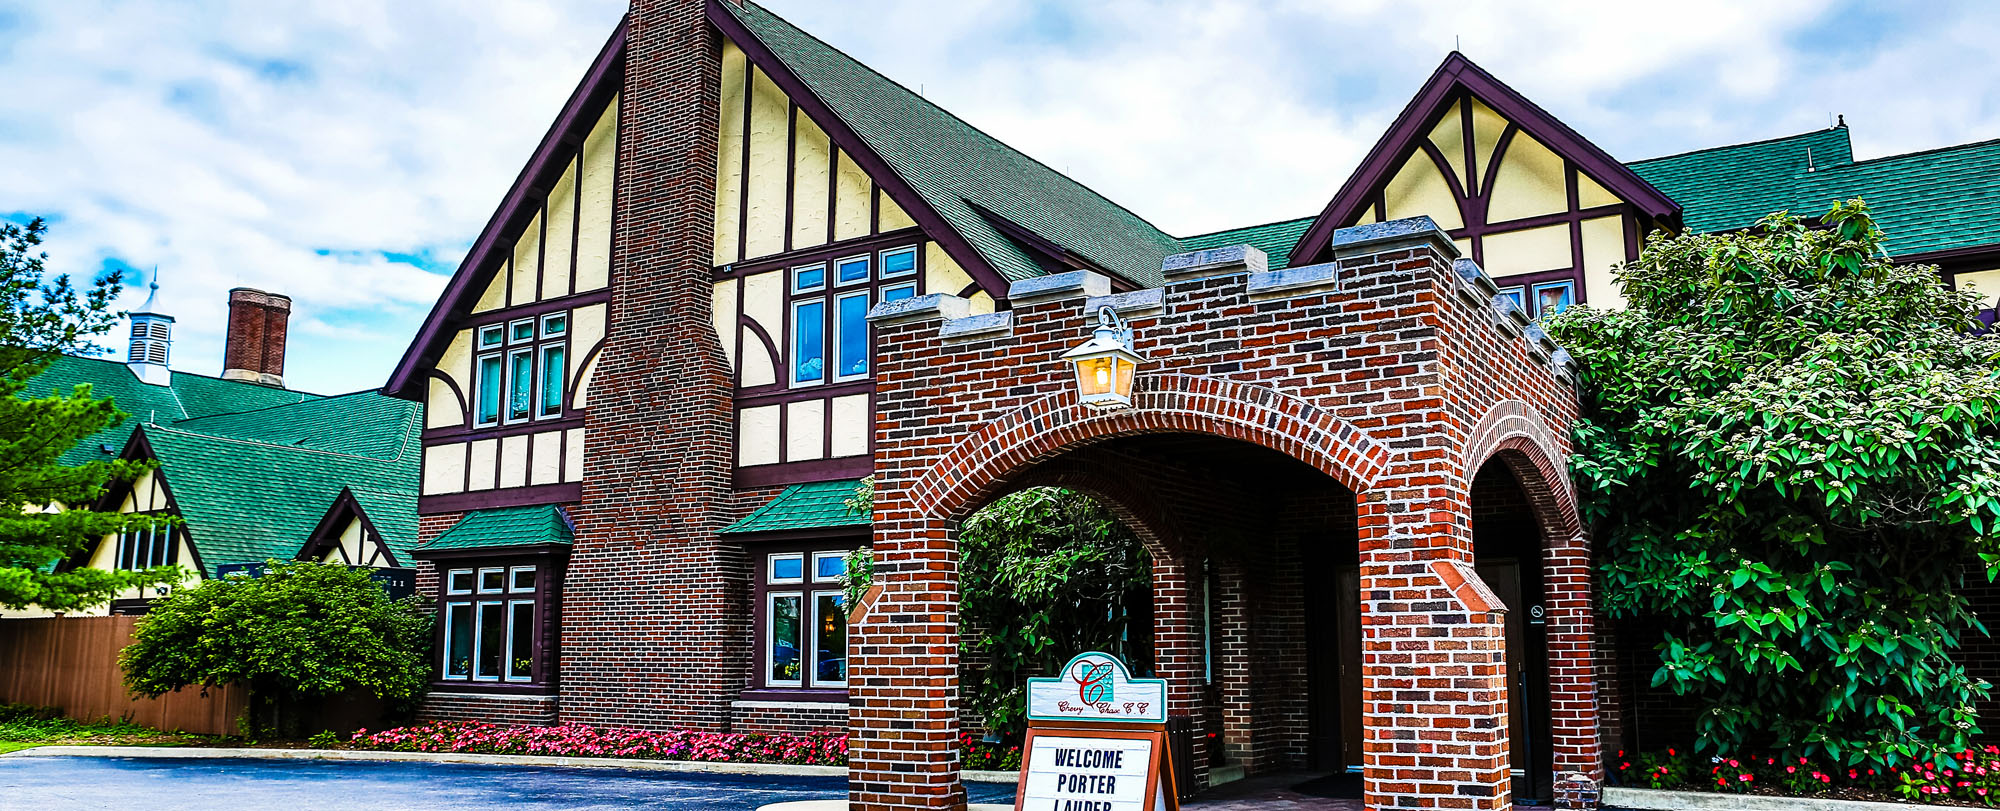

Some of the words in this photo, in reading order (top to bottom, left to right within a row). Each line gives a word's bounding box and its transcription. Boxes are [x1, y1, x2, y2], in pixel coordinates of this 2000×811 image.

[1058, 700, 1084, 715] Chevy
[1096, 702, 1120, 714] Chase
[1055, 748, 1123, 769] WELCOME
[1057, 773, 1116, 794] PORTER
